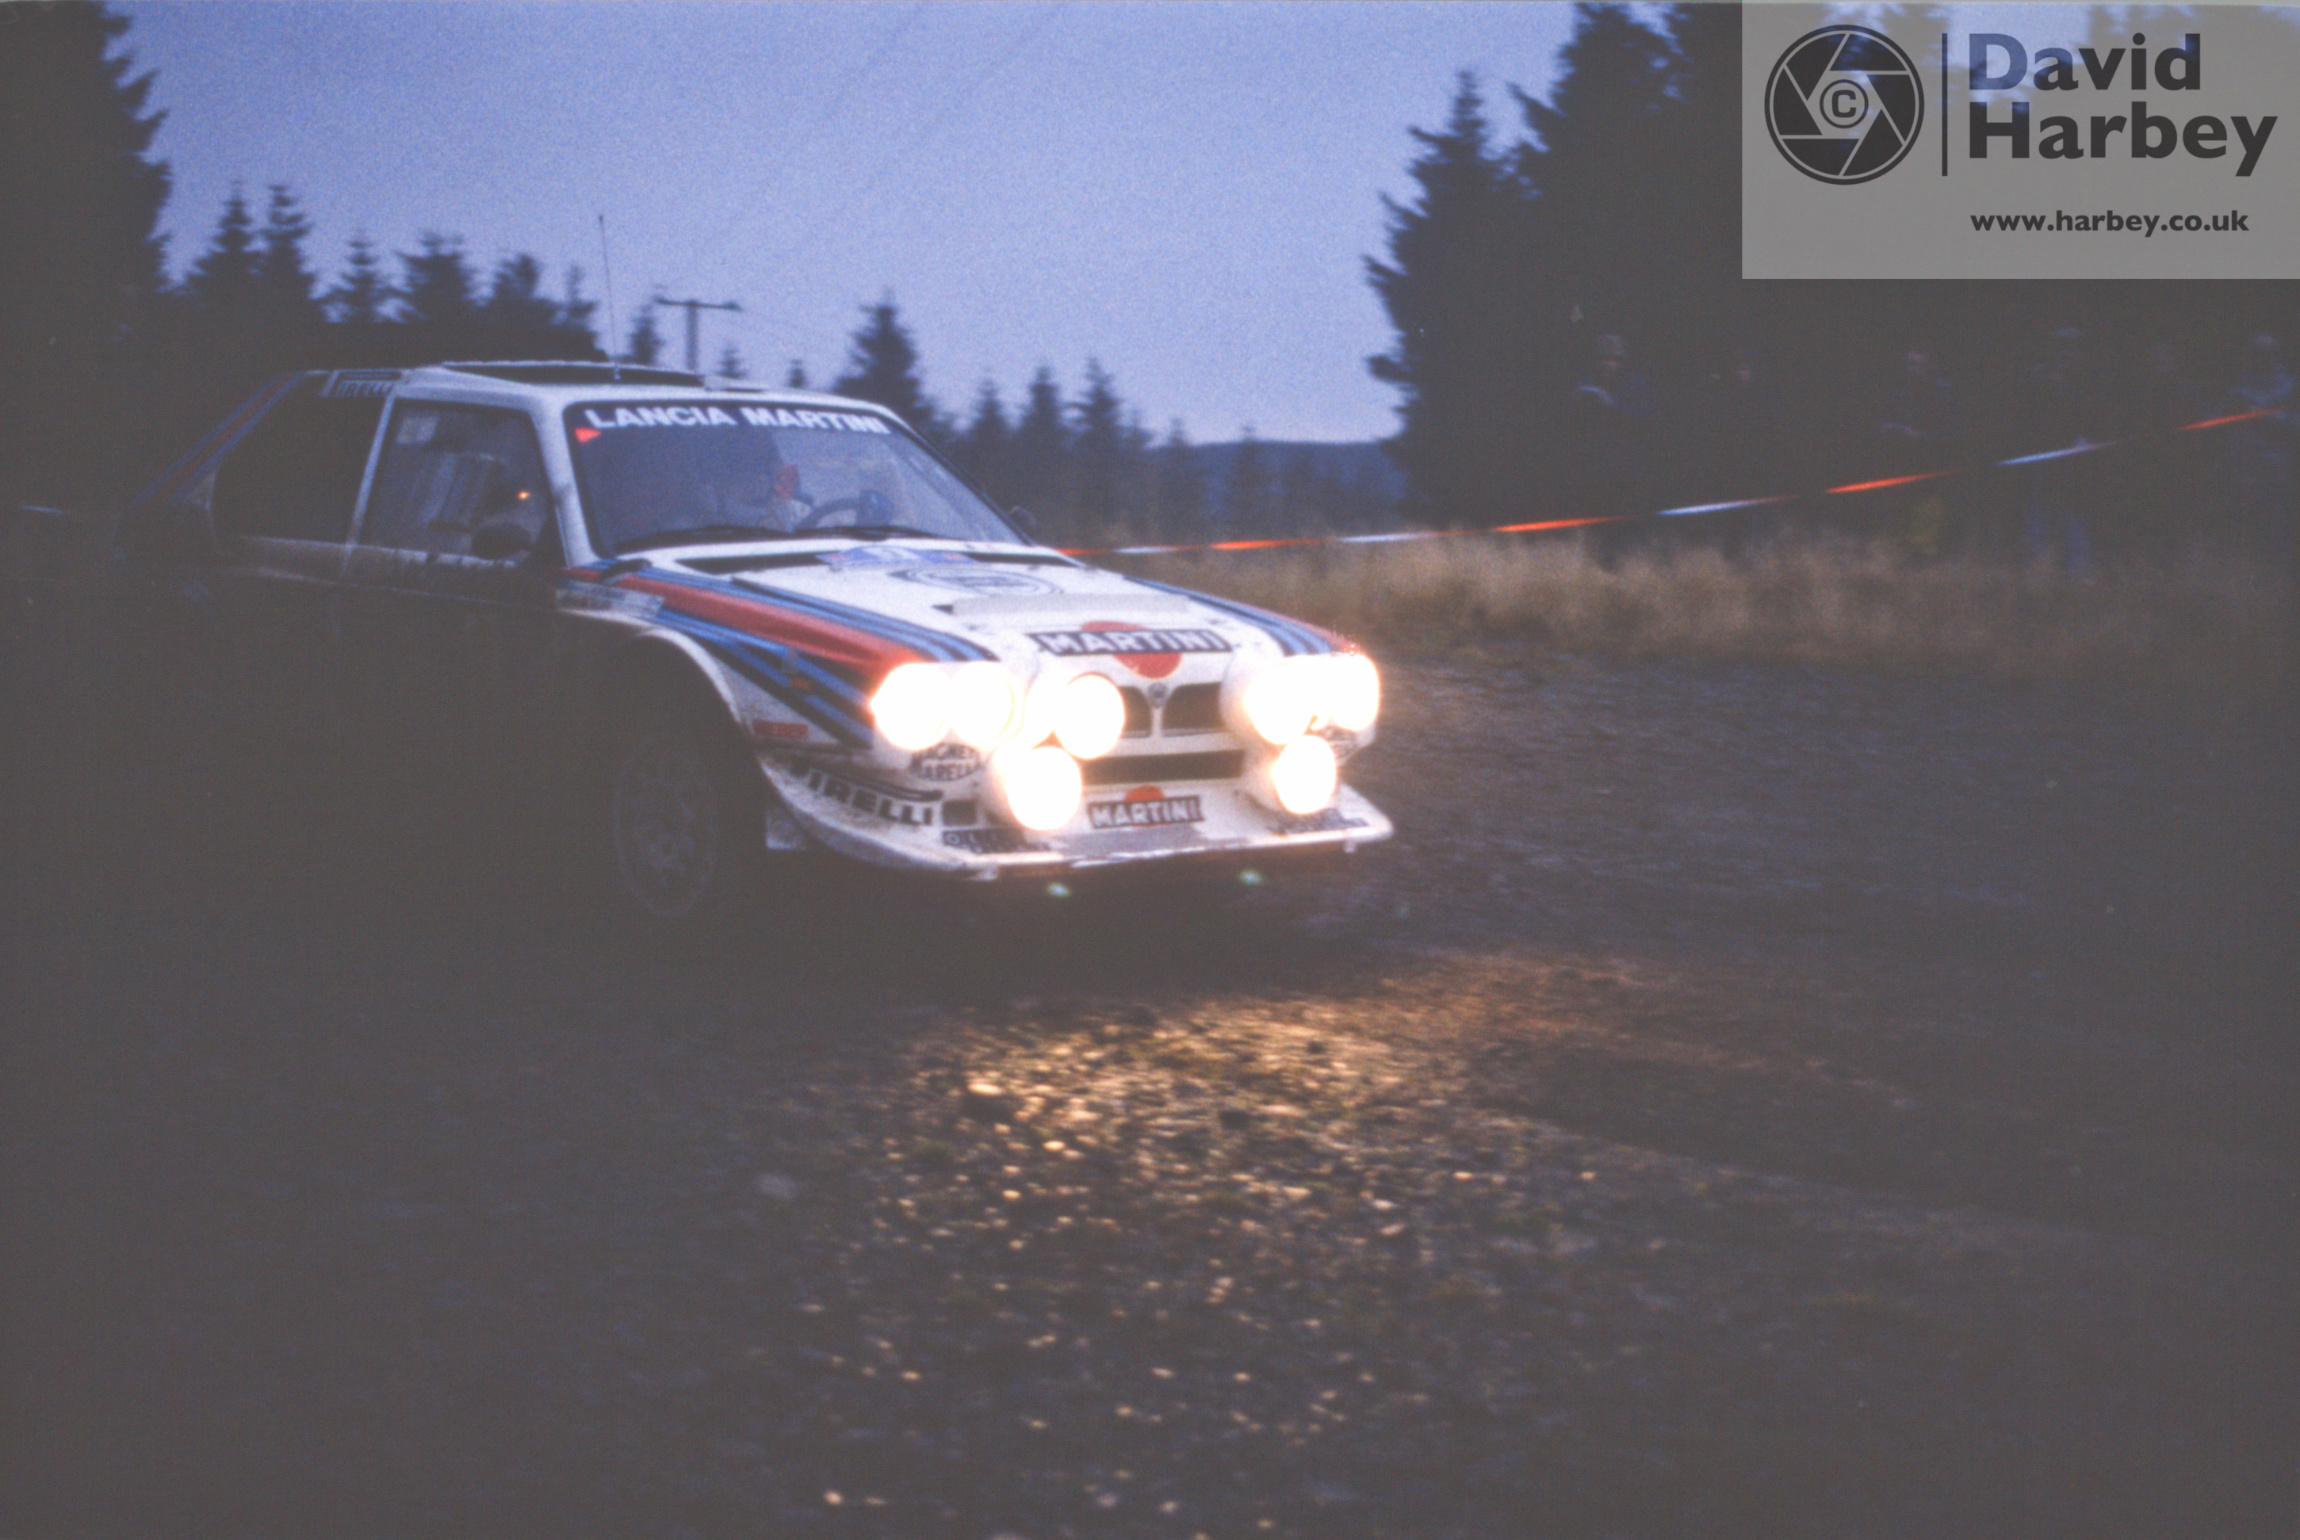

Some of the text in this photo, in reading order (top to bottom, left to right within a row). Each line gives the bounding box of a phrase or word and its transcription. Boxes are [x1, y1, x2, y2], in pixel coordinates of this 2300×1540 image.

[585, 406, 892, 435] LANCIA MARTINI
[1033, 630, 1230, 653] MARTINI
[1090, 799, 1201, 827] MARTINI
